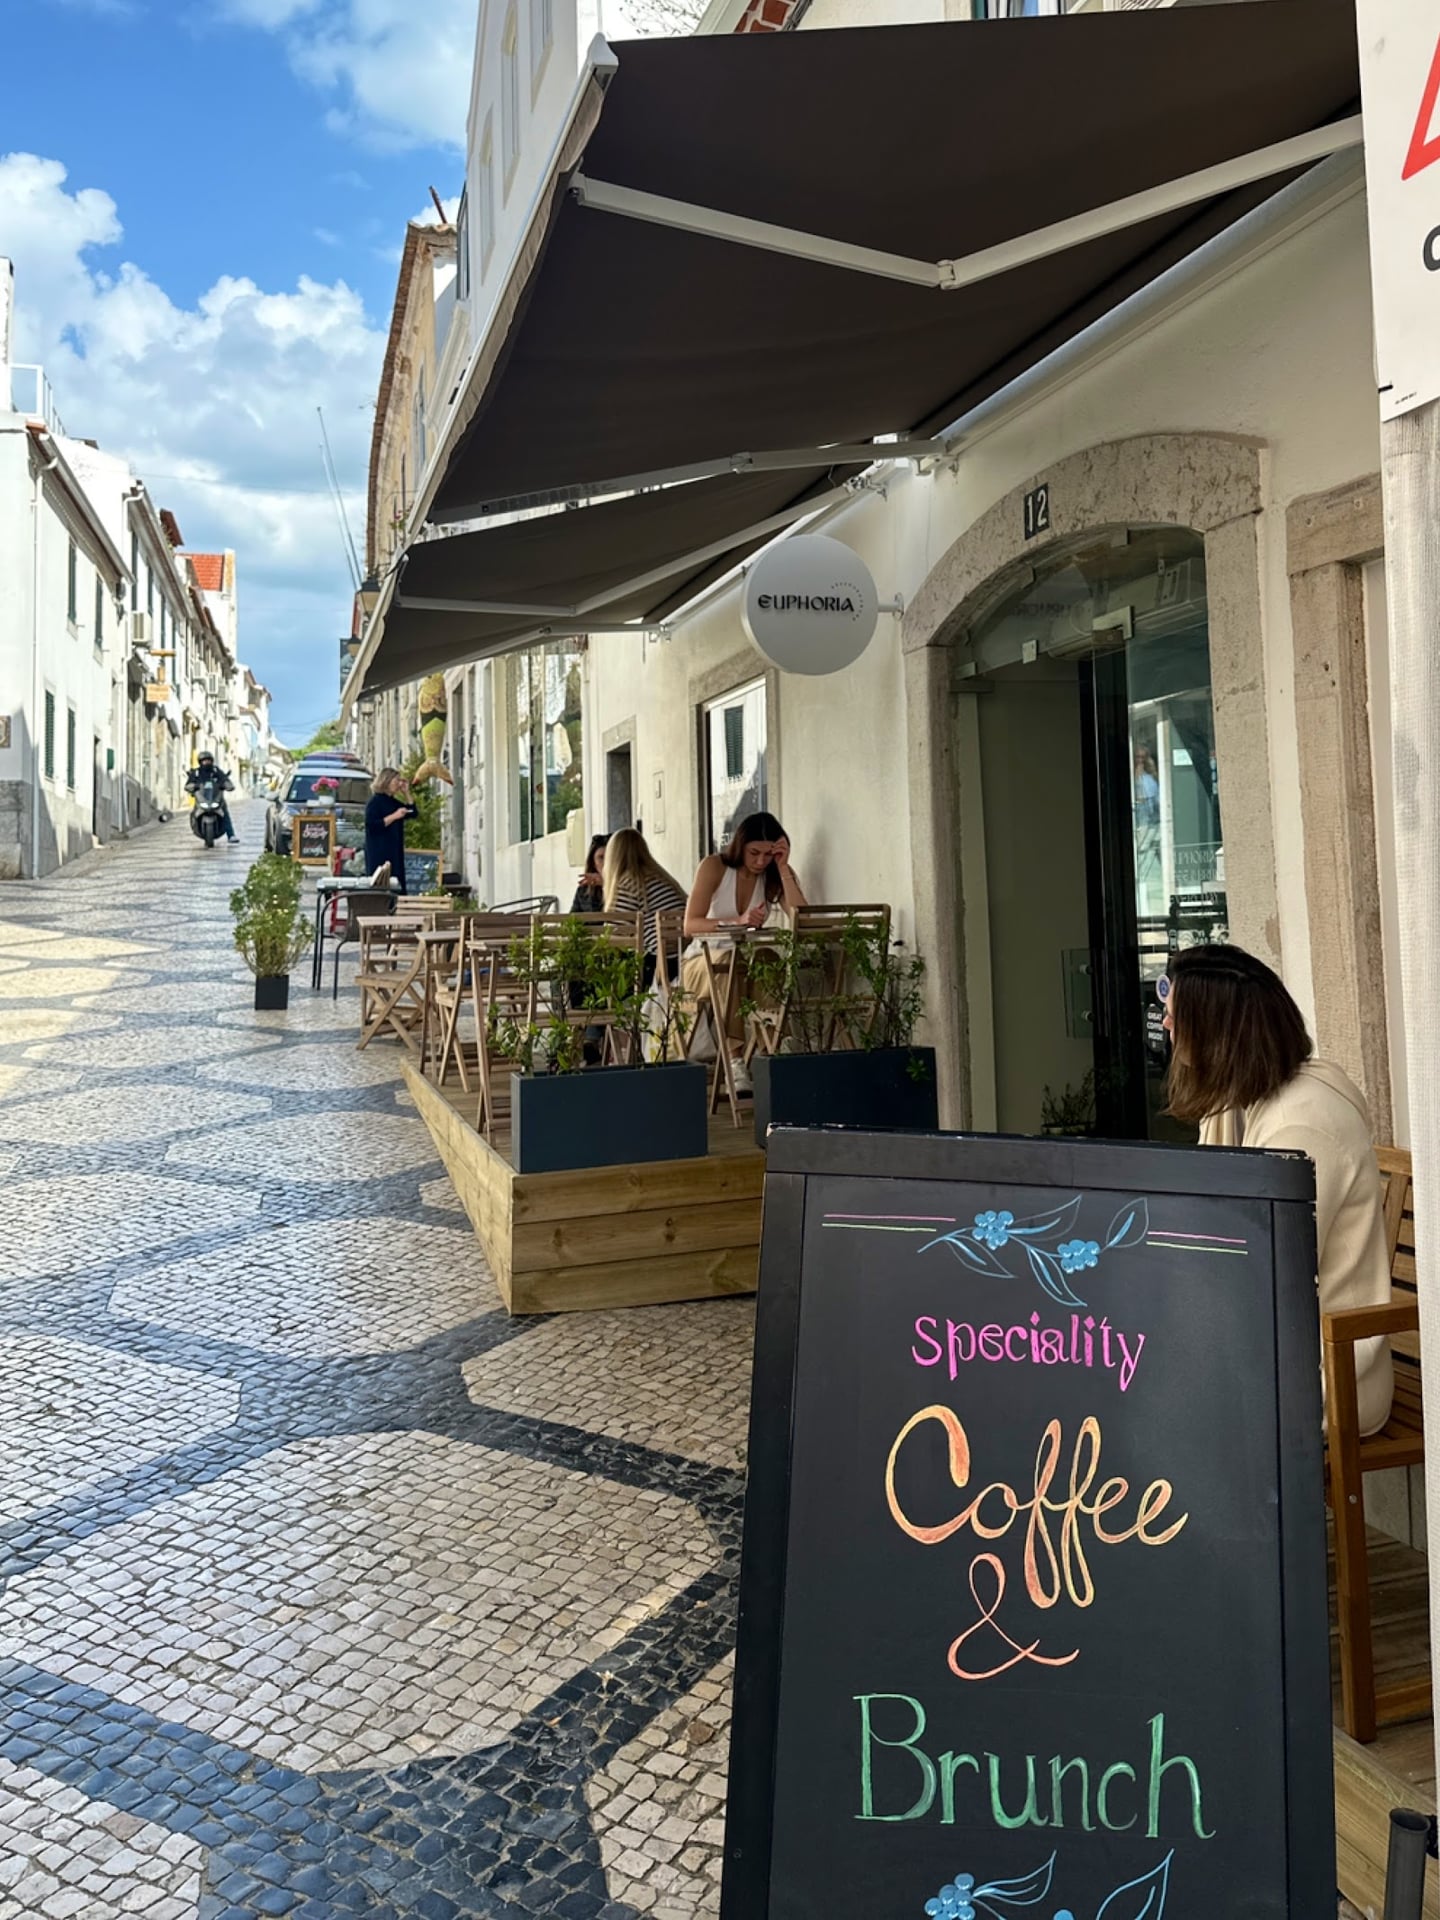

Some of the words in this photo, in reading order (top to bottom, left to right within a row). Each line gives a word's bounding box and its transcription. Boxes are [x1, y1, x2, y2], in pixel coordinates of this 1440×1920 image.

[1028, 489, 1046, 532] 12
[757, 594, 855, 612] EUPHORIA
[885, 1404, 1190, 1608] Coffee
[947, 1552, 1080, 1680] &
[852, 1692, 1217, 1839] Brunch
